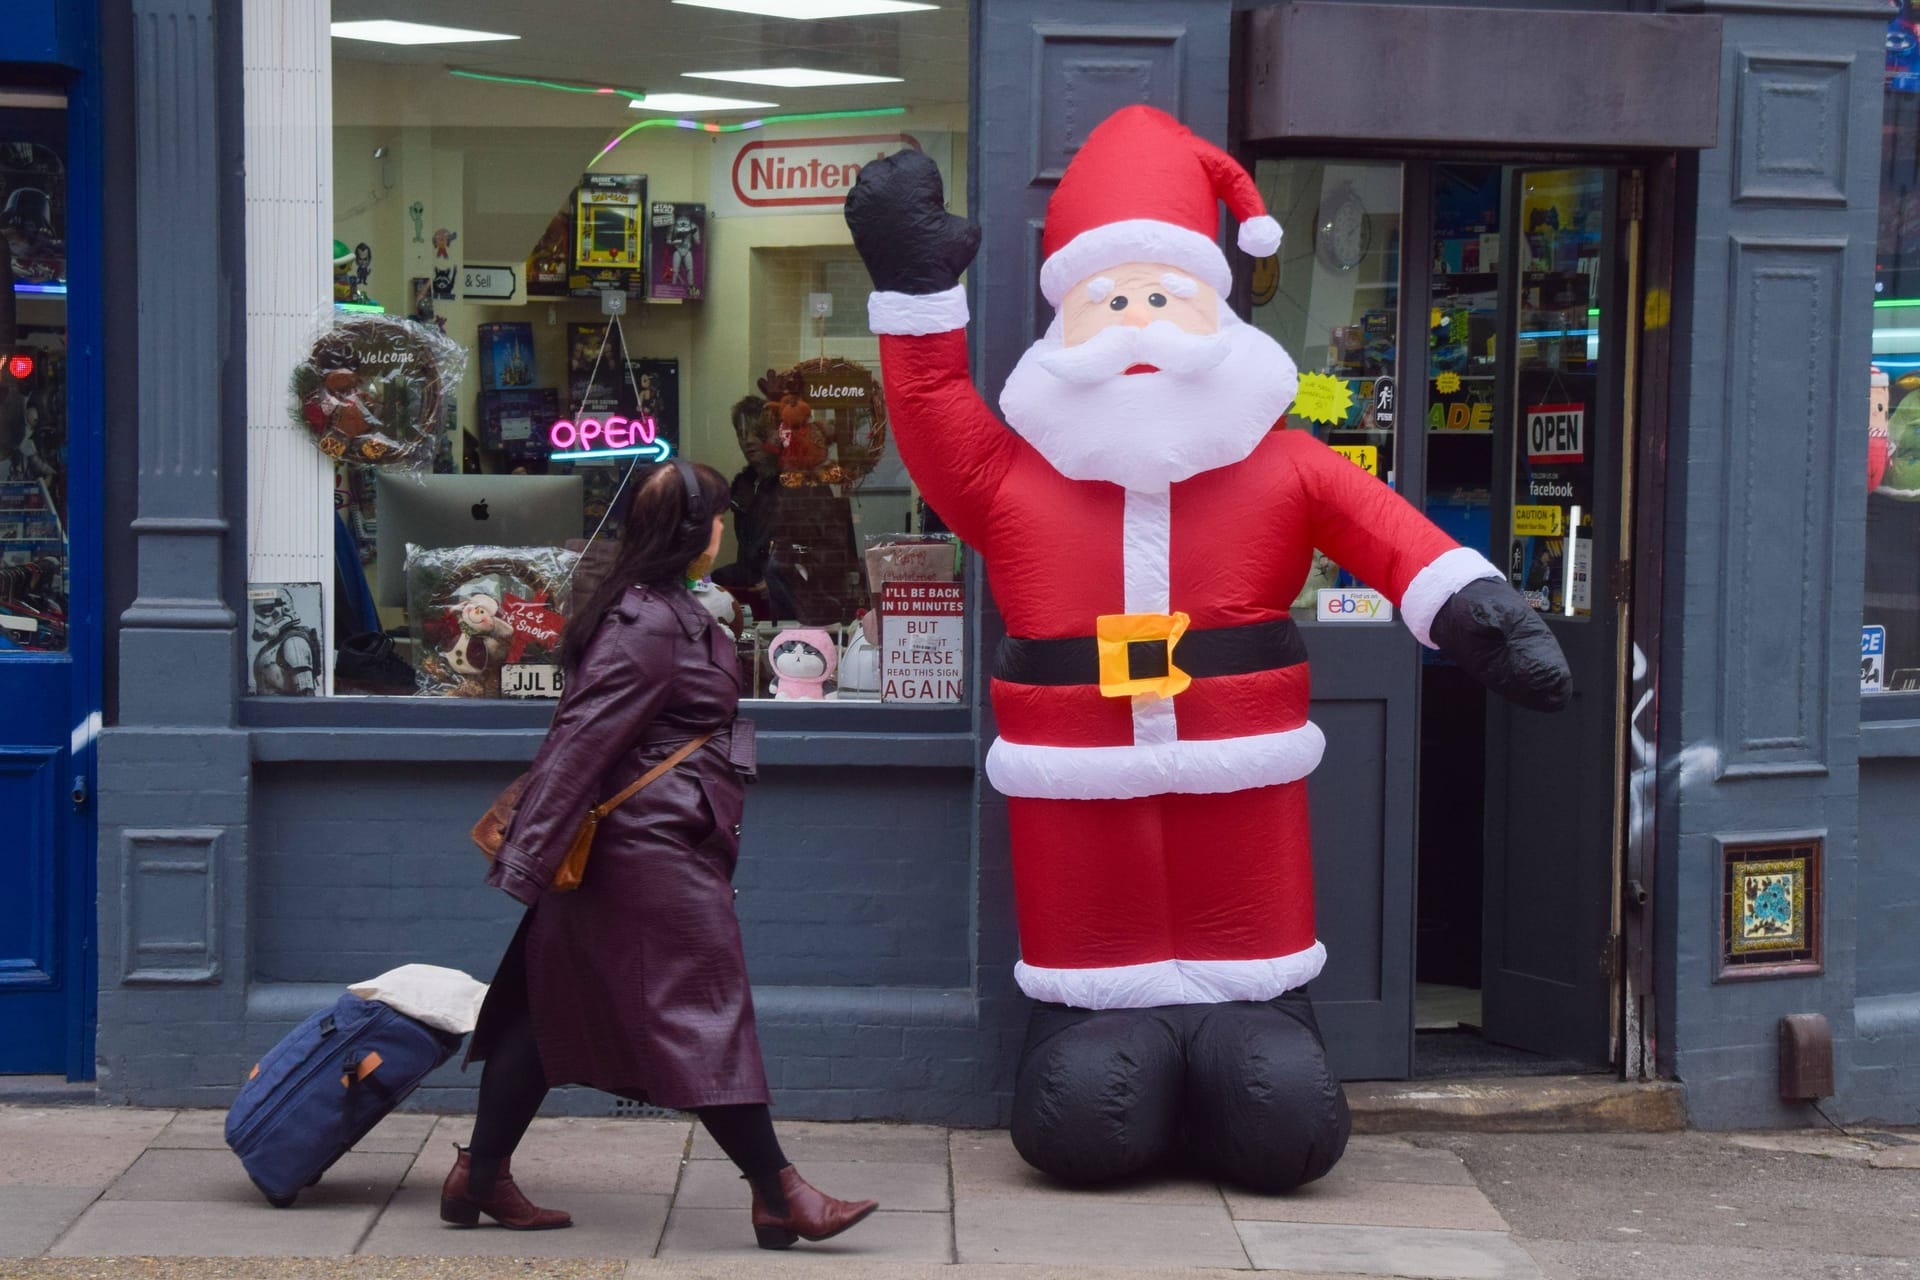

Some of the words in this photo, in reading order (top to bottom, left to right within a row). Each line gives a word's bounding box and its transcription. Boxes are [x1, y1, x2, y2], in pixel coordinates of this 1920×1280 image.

[751, 152, 886, 190] Ninten
[465, 275, 473, 288] &
[475, 274, 491, 288] Sell
[359, 350, 414, 365] Welcome
[809, 384, 864, 398] Welcome
[551, 416, 655, 450] OPEN
[1532, 414, 1578, 452] OPEN
[1530, 481, 1573, 497] facebook
[1516, 510, 1547, 520] CAUTION
[886, 588, 907, 598] I'LL
[911, 588, 927, 598] BE
[928, 588, 960, 598] BACK
[882, 601, 893, 611] IN
[898, 601, 908, 611] 10
[913, 601, 964, 611] MINUTES
[1328, 594, 1381, 617] ebay
[516, 604, 544, 623] Let
[516, 619, 554, 640] Snow
[907, 621, 938, 634] BUT
[898, 638, 907, 646] IF
[891, 651, 953, 664] PLEASE
[887, 669, 911, 677] READ
[914, 669, 934, 677] THIS
[937, 669, 959, 677] SIGN
[513, 672, 545, 691] JJL
[884, 679, 961, 699] AGAIN
